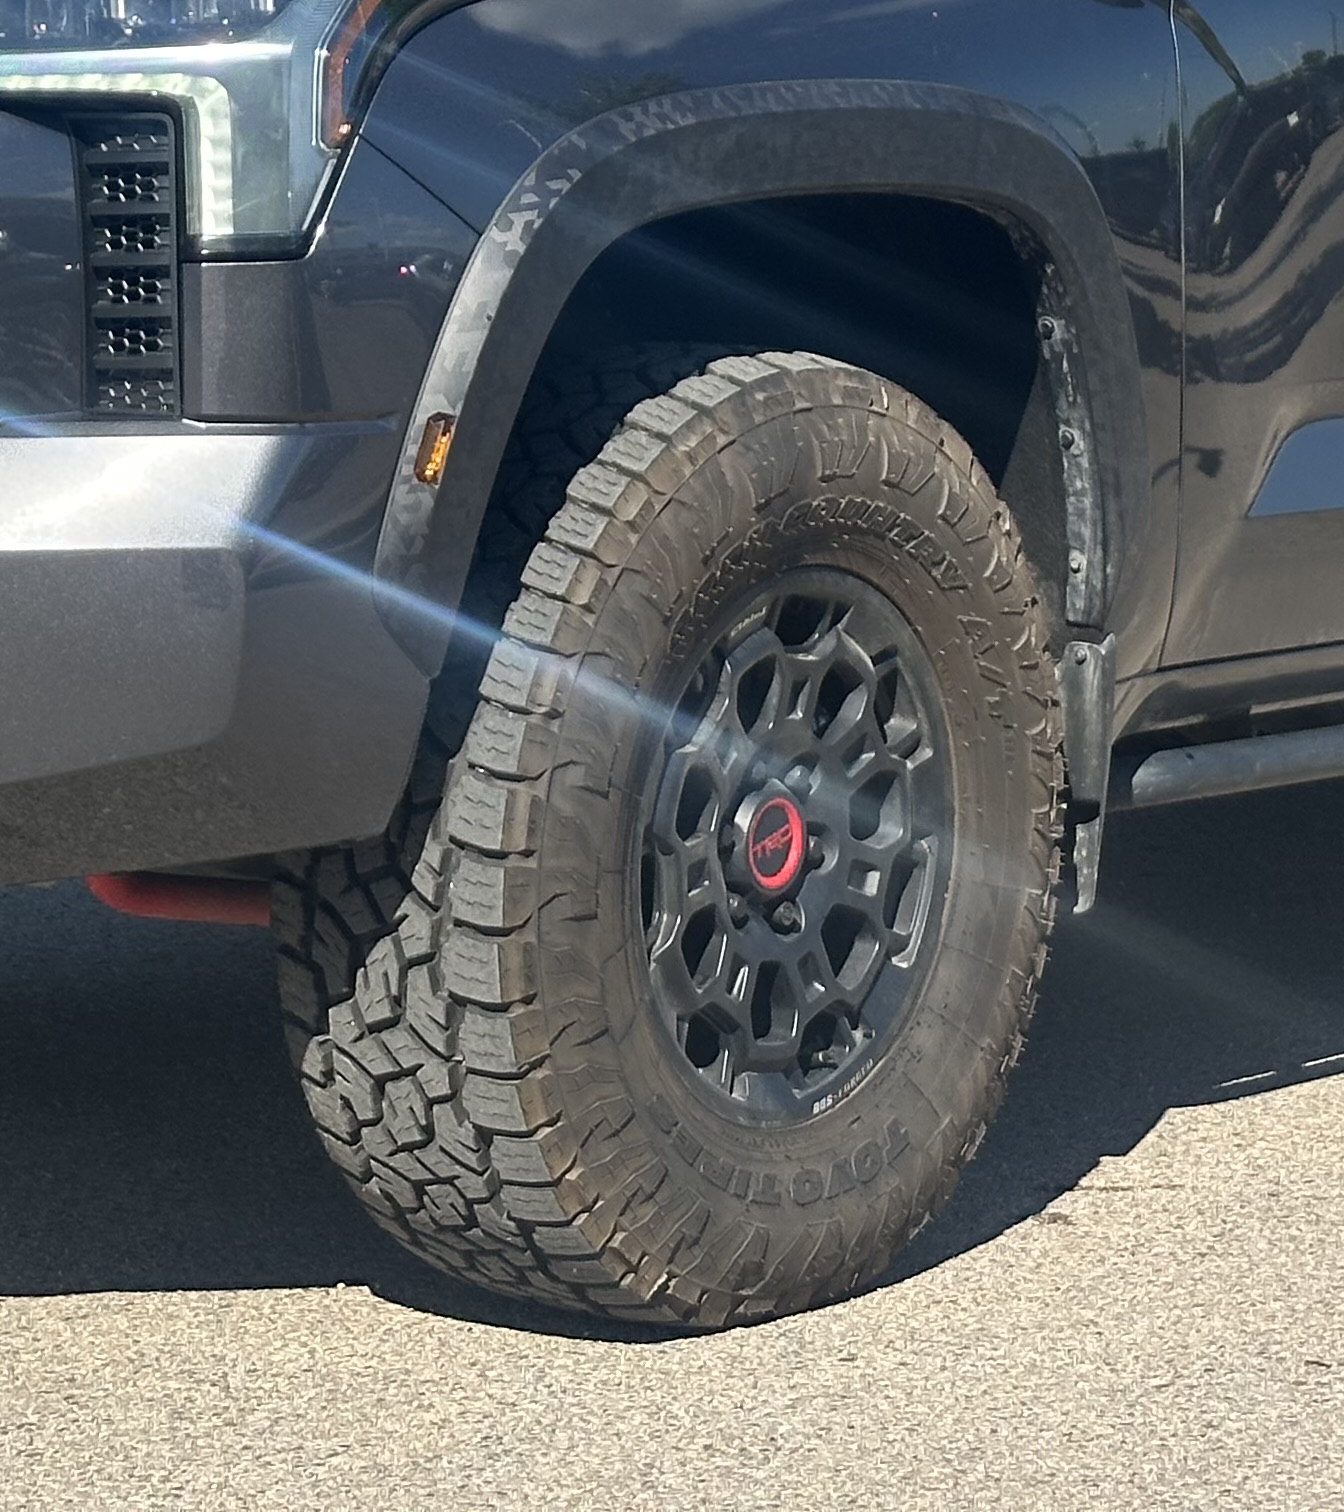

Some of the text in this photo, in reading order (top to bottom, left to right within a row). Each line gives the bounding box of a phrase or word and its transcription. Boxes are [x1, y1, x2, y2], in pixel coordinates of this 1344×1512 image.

[752, 823, 792, 859] TRD
[650, 1094, 911, 1207] TOYO TIRES
